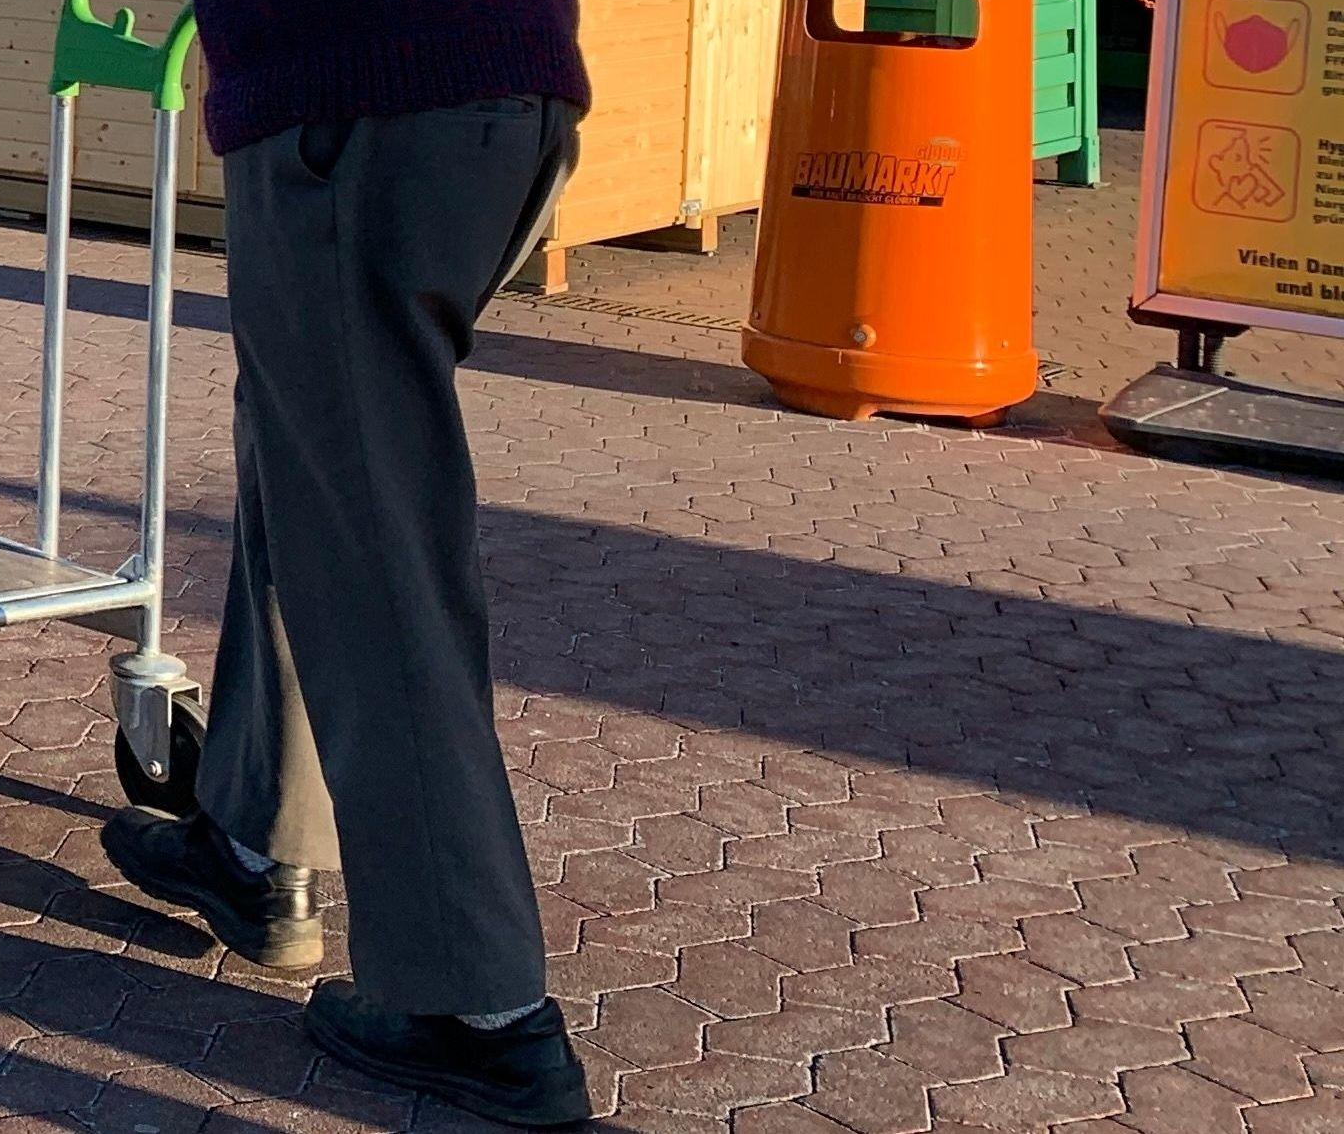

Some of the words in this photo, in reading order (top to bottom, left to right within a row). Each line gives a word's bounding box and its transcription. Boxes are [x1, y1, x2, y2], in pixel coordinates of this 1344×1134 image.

[793, 151, 956, 197] BAUMARKT
[1238, 249, 1299, 271] Vielen
[1306, 257, 1344, 277] Dan
[1276, 282, 1313, 297] und
